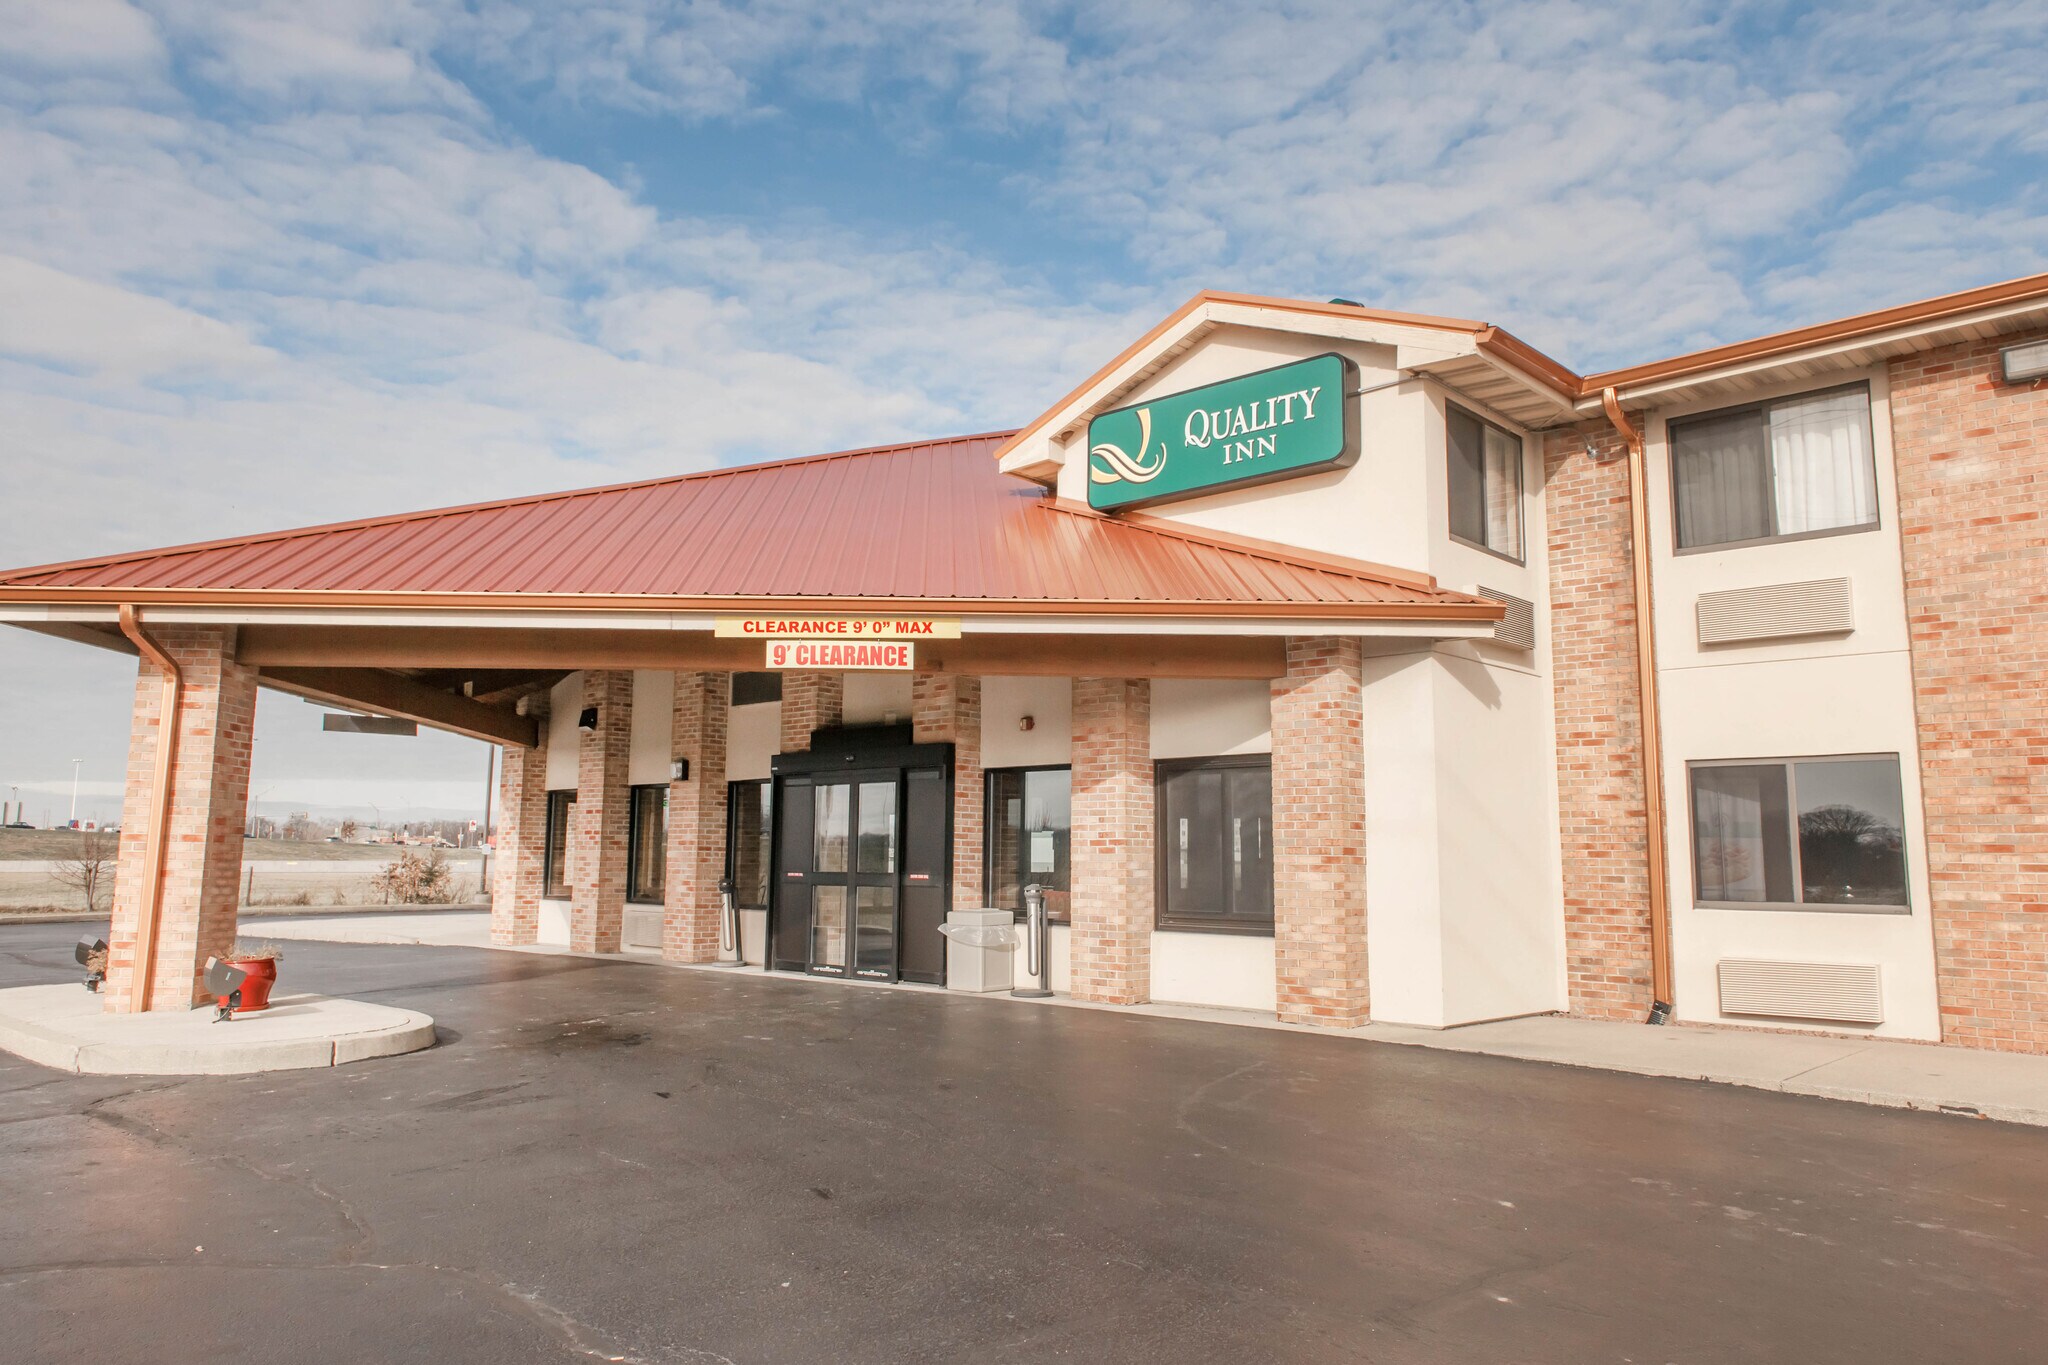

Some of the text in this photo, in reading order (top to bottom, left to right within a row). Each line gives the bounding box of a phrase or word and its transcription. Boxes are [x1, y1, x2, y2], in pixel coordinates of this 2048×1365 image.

[1185, 387, 1320, 448] QUALITY
[1223, 434, 1276, 465] INN
[743, 620, 847, 633] CLEARANCE
[895, 621, 933, 634] MAX
[795, 645, 907, 667] CLEARANCE
